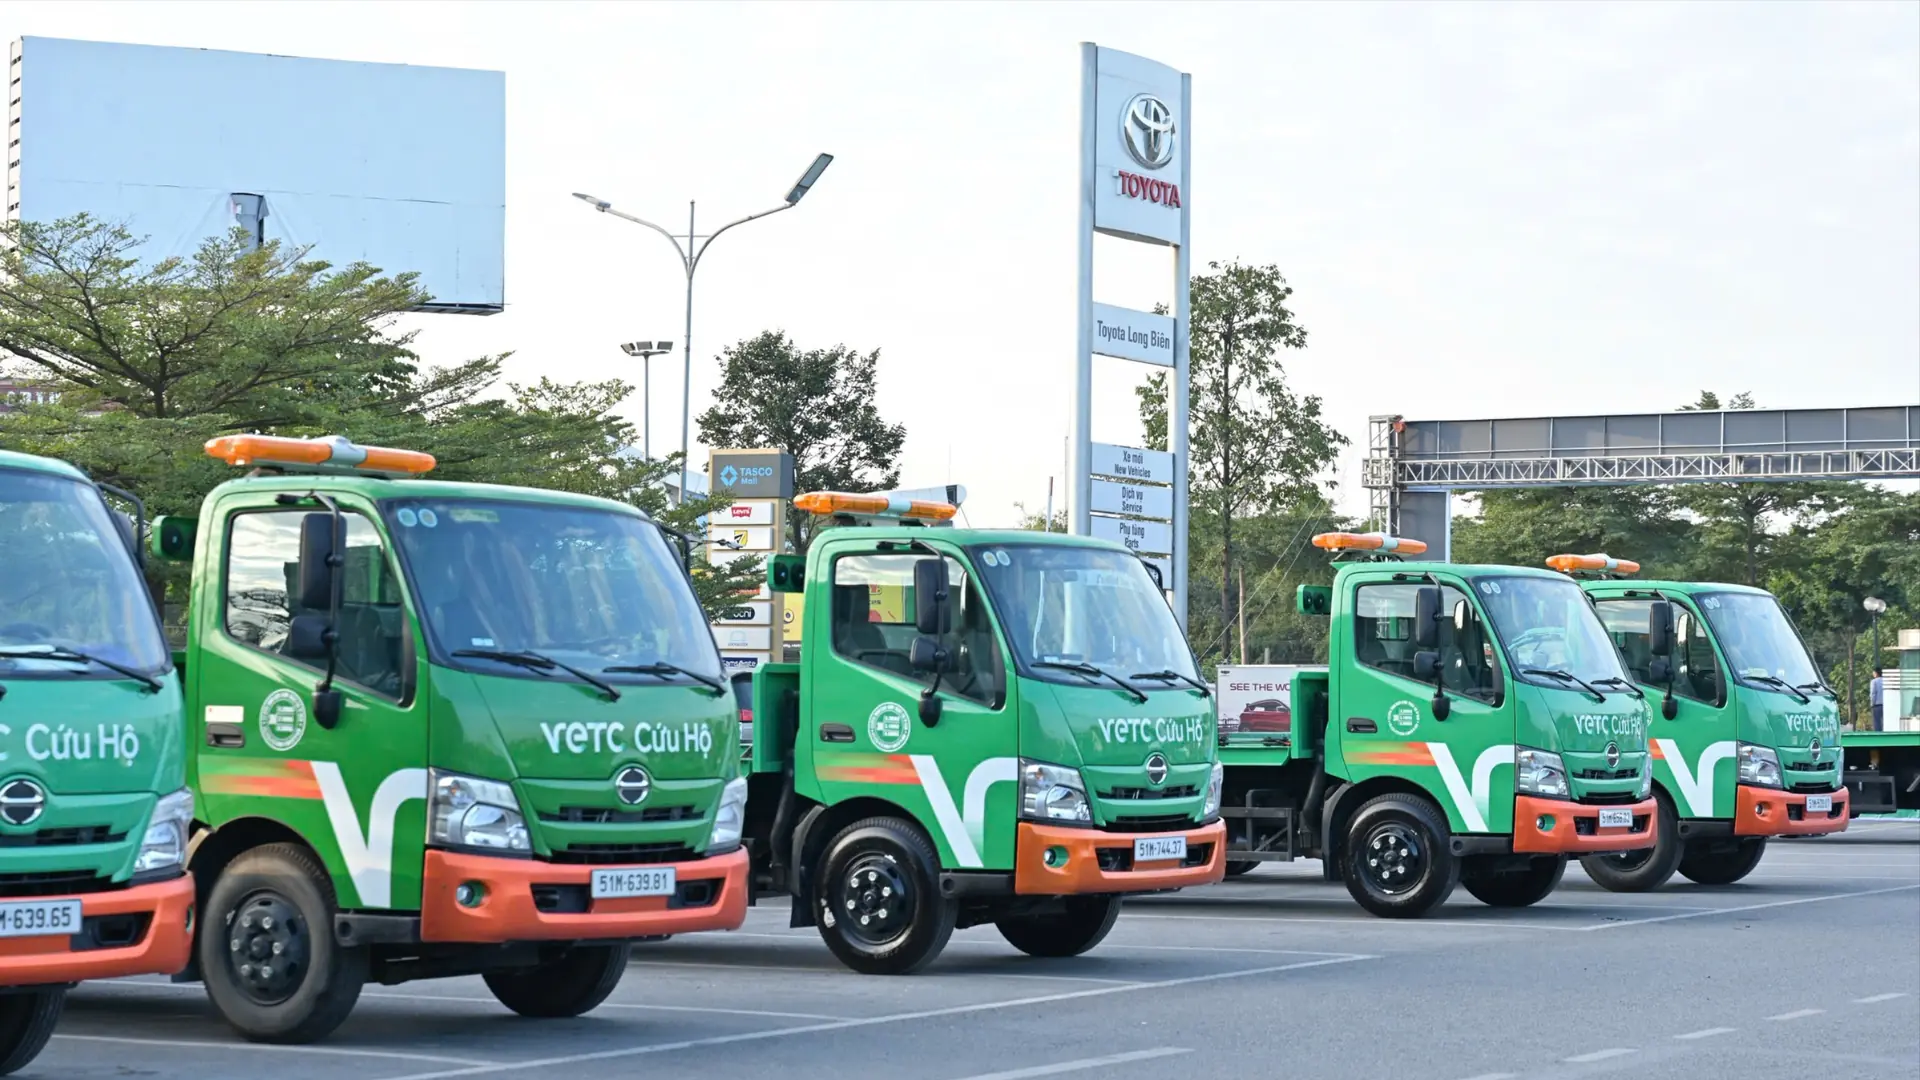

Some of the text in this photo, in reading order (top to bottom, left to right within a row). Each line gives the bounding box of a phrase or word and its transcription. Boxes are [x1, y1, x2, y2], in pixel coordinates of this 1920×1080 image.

[1118, 170, 1181, 208] TOYOTA
[1097, 320, 1170, 349] Toyota Long Biên
[1122, 450, 1131, 462] Xe
[740, 467, 773, 476] TASCO
[1114, 464, 1151, 478] New Vehicles
[1121, 487, 1135, 501] Dịch
[1121, 501, 1142, 513] Service
[1119, 522, 1131, 538] Phụ
[1124, 537, 1139, 549] Parts
[1229, 682, 1250, 691] SEE
[1252, 683, 1273, 691] THE
[634, 722, 680, 753] Cứu
[684, 722, 712, 758] Hộ
[1155, 717, 1184, 742] Cứu
[1185, 718, 1203, 748] Hộ
[25, 723, 91, 761] Cứu
[97, 723, 140, 767] Hộ
[1139, 841, 1182, 856] 51M-744.37
[599, 874, 668, 892] 51M-639.81
